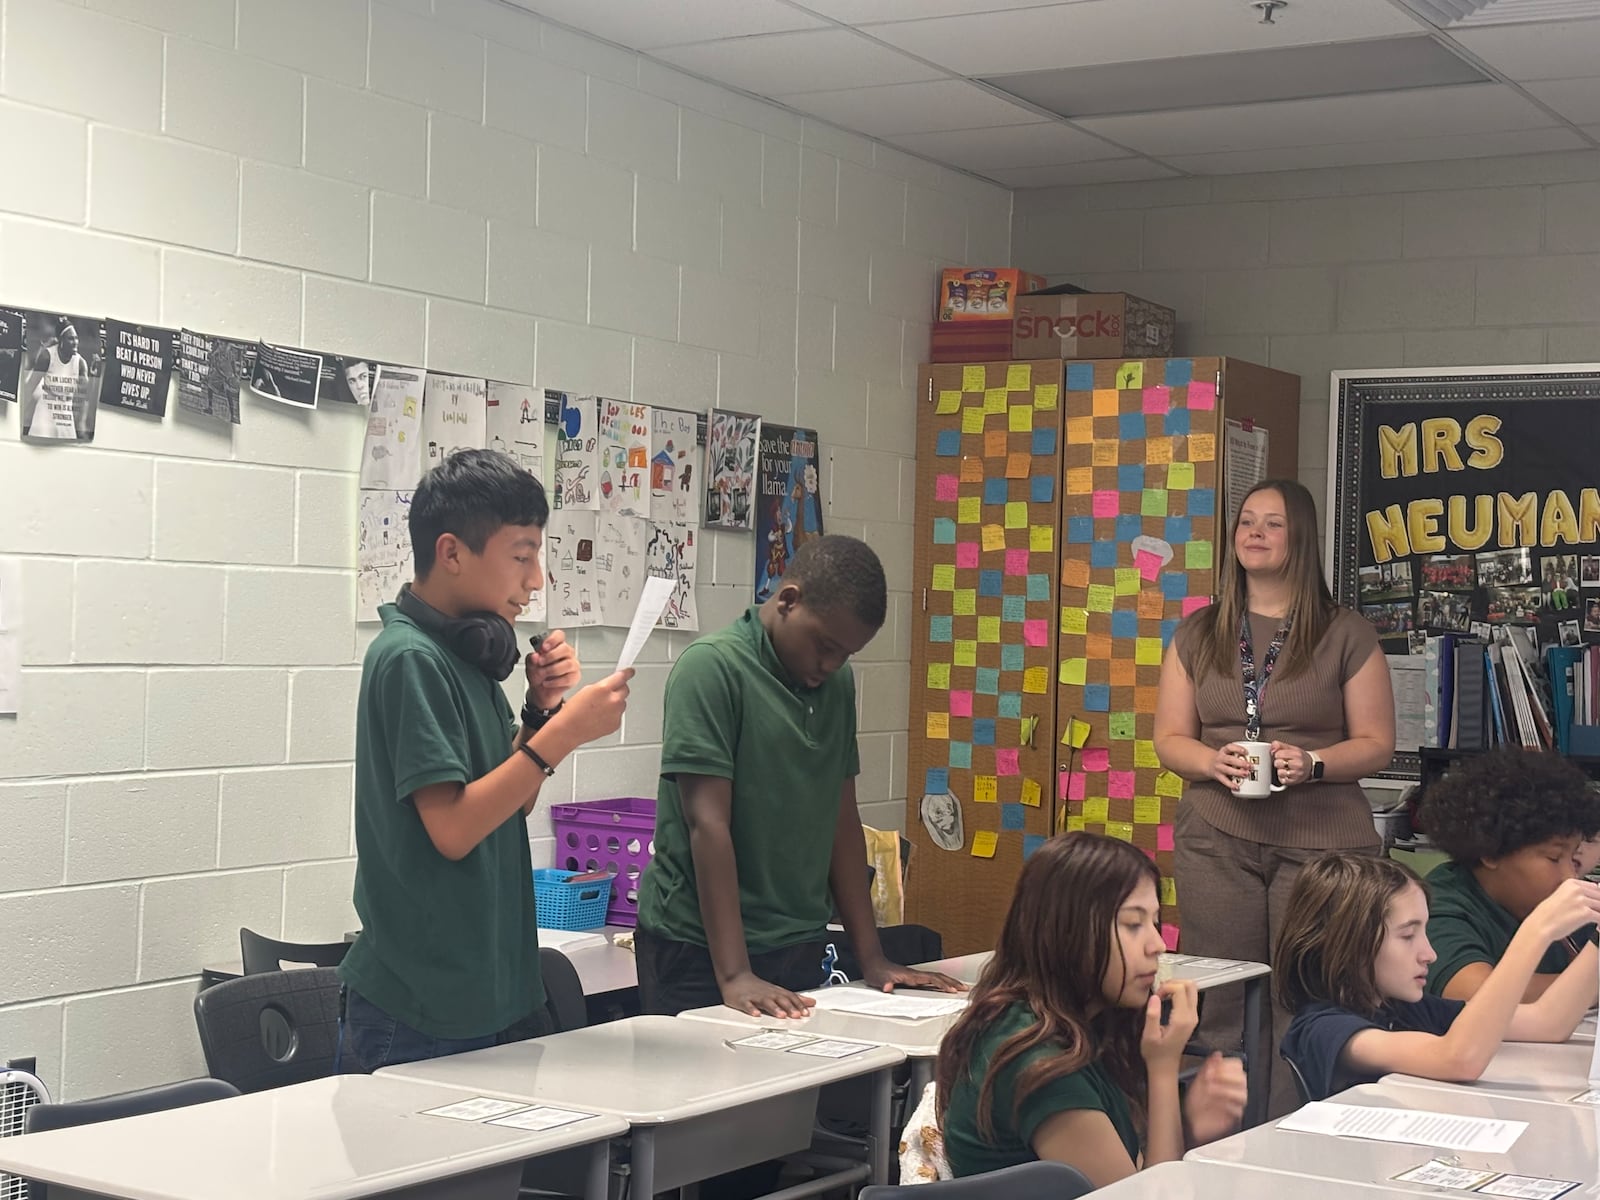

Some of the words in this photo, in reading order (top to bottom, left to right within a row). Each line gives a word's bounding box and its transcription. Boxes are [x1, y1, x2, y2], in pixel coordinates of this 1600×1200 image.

[120, 331, 132, 346] IT'S
[133, 334, 151, 350] HARD
[151, 338, 160, 353] TO
[116, 346, 132, 361] BEAT
[133, 350, 138, 364] A
[138, 351, 163, 370] PERSON
[121, 364, 136, 379] WHO
[136, 368, 156, 384] NEVER
[121, 381, 140, 397] GIVES
[777, 435, 790, 455] the
[1378, 414, 1504, 479] MRS
[761, 453, 772, 472] for
[773, 459, 792, 480] your
